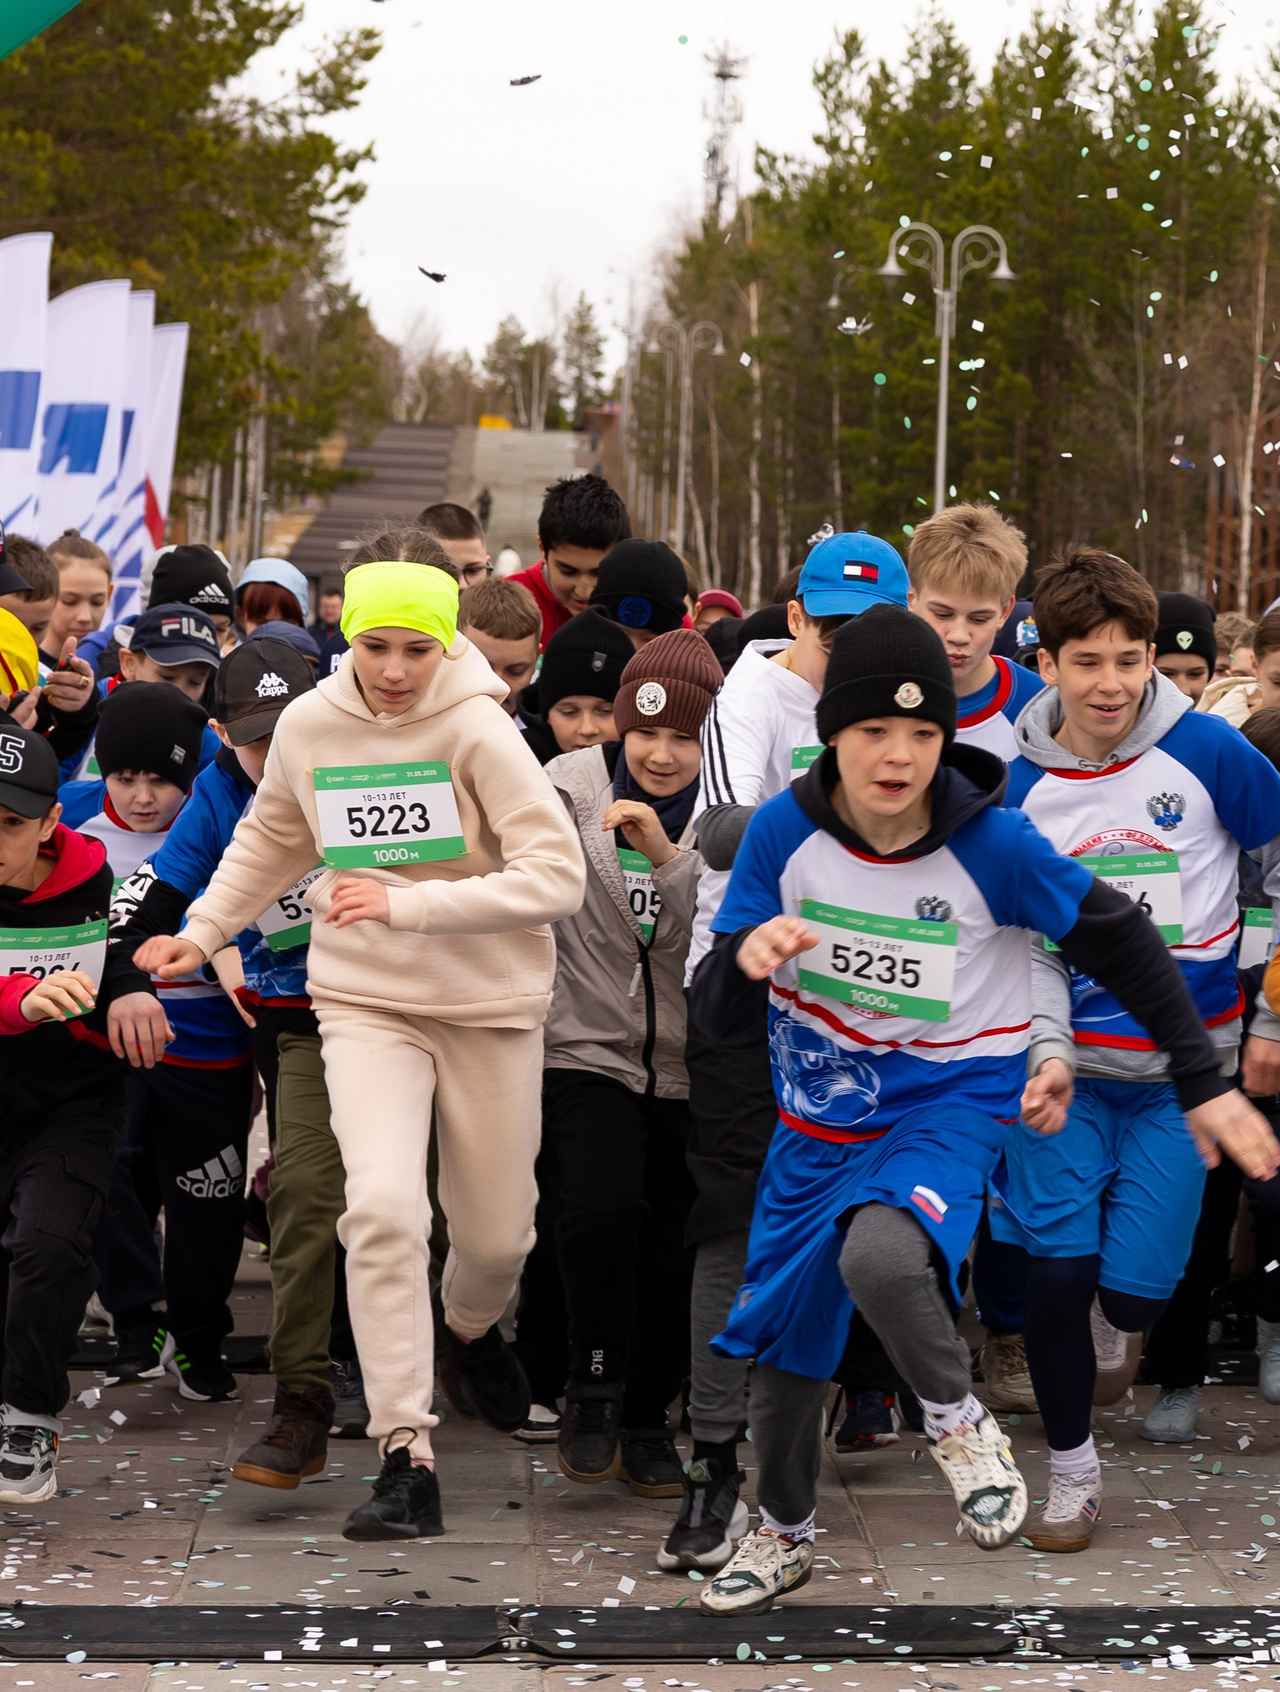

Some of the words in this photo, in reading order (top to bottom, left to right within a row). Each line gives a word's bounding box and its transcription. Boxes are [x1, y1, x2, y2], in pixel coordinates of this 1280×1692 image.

[189, 594, 230, 605] adidas
[161, 617, 216, 645] FILA
[362, 793, 387, 802] 10-13
[389, 791, 407, 800] ЛЕТ
[346, 802, 431, 838] 5223
[373, 848, 409, 862] 1000
[29, 955, 53, 963] 10-13
[54, 952, 71, 961] ЛЕТ
[830, 943, 922, 988] 5235
[850, 989, 888, 1007] 1000
[176, 1176, 243, 1198] adida
